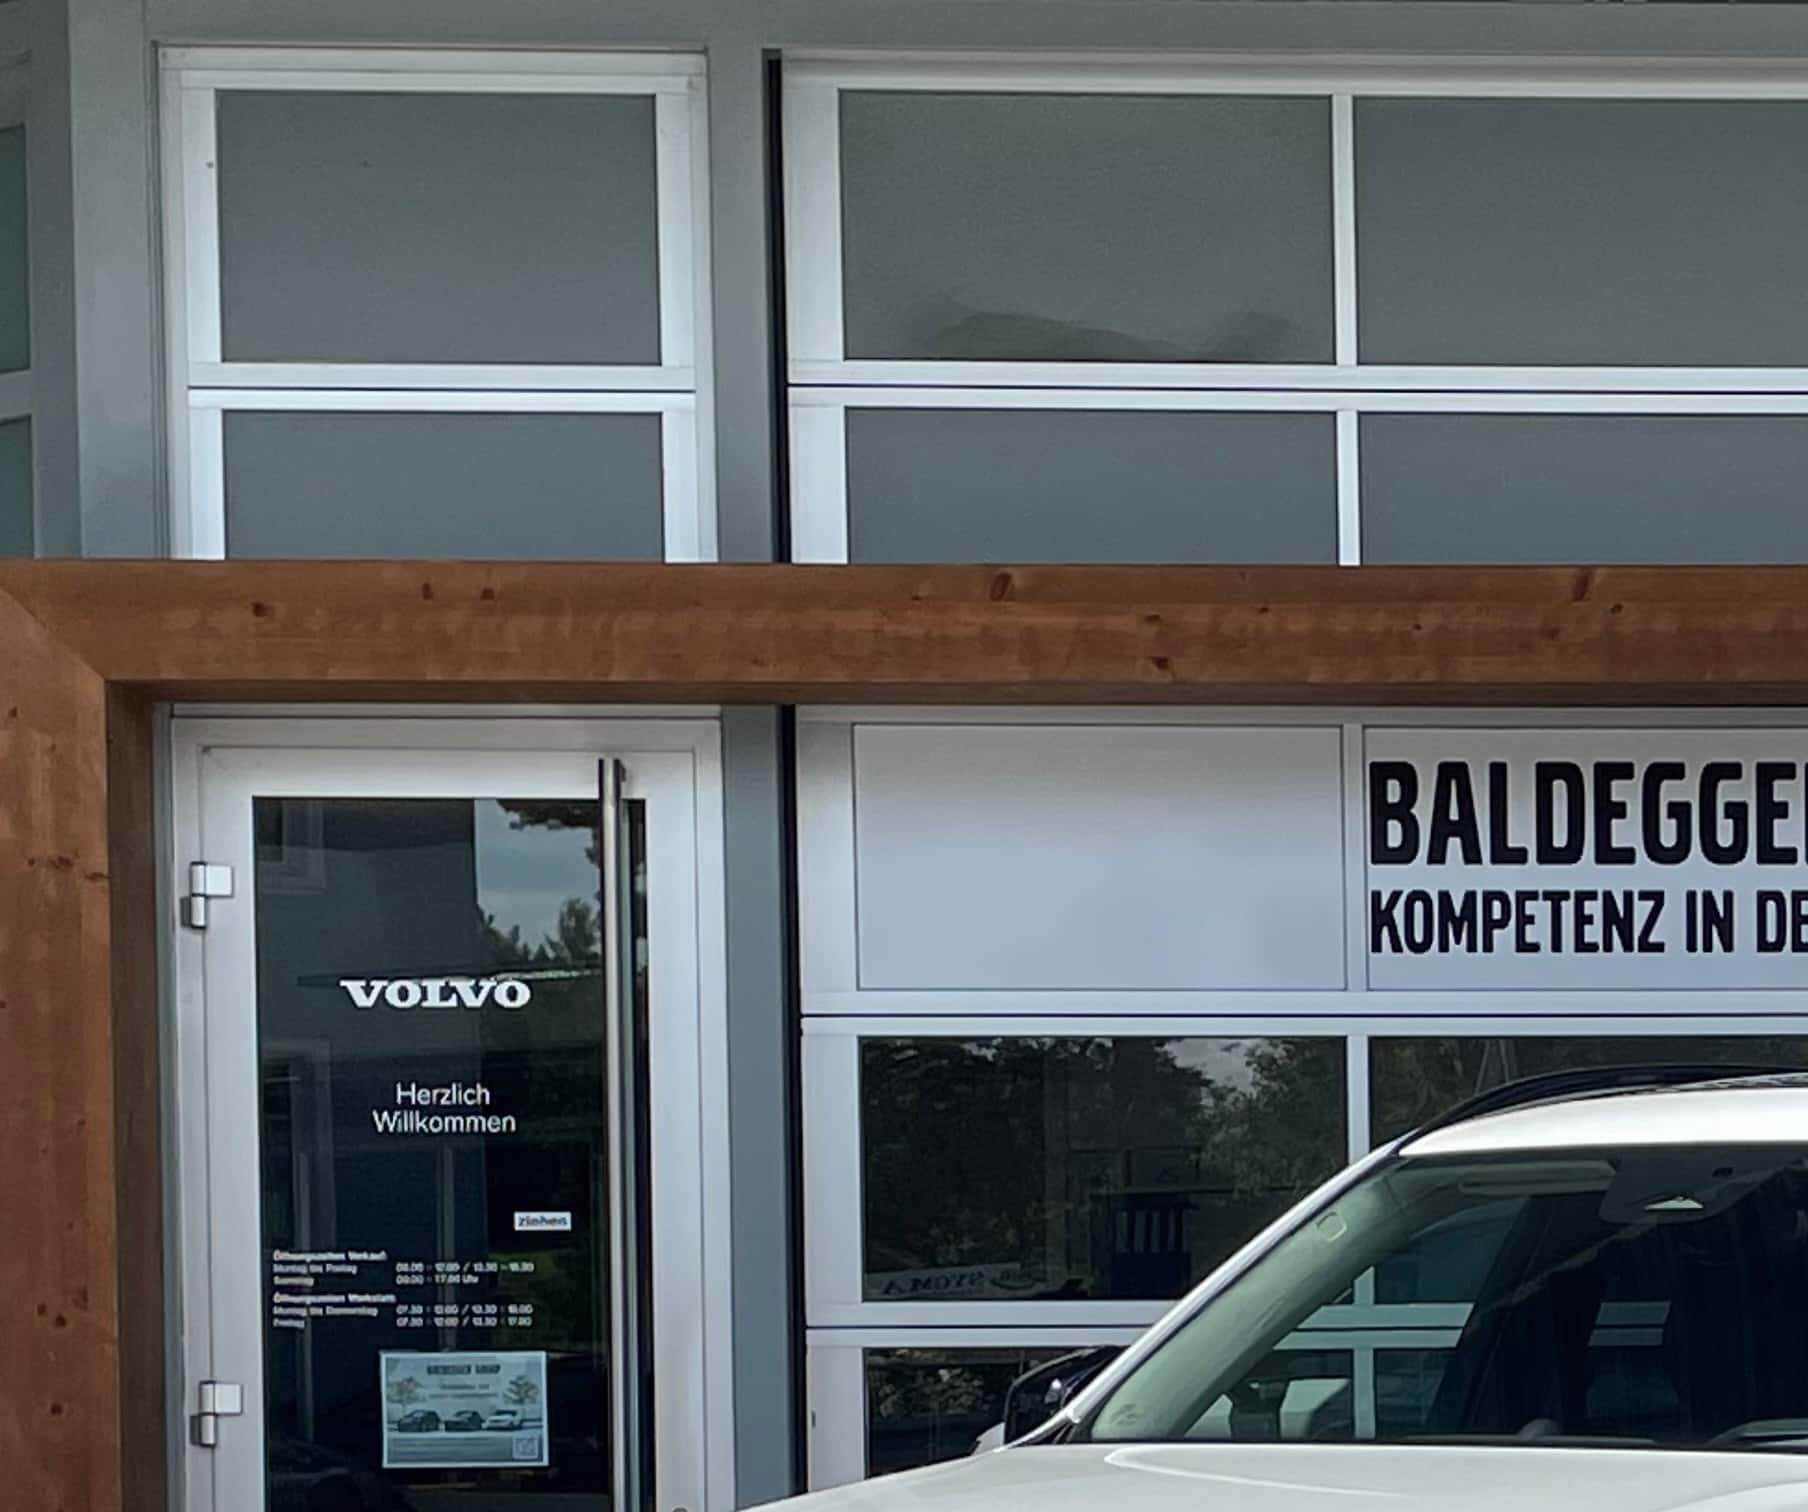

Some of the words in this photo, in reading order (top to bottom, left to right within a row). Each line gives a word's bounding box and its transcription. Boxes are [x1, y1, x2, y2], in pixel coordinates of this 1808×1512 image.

[1369, 888, 1665, 953] KOMPETENZ
[1685, 888, 1735, 953] IN
[340, 978, 532, 1009] VOLVO
[395, 1082, 491, 1106] Herzlich
[372, 1110, 517, 1134] Willkommen
